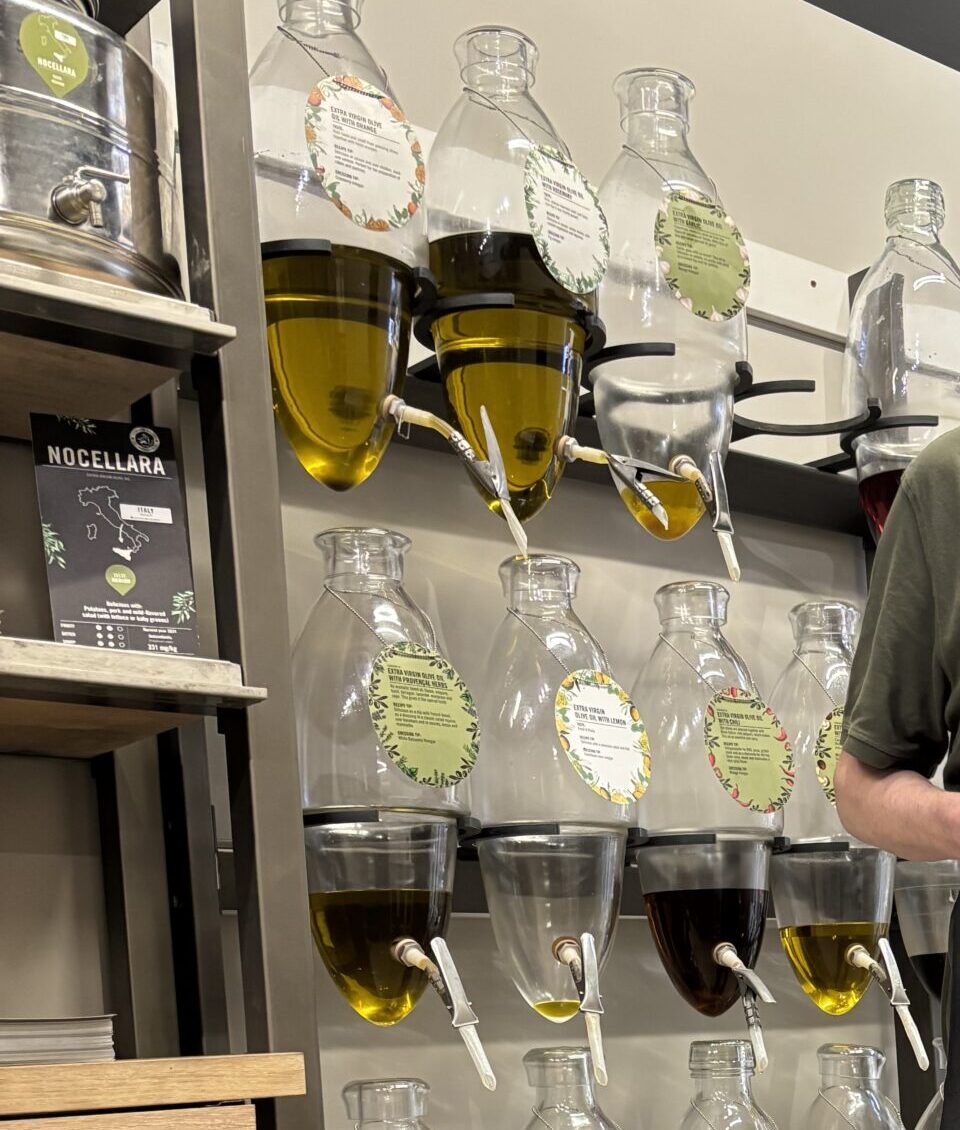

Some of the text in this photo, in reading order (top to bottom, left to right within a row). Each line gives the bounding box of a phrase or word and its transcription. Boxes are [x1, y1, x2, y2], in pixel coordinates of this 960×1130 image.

[38, 57, 76, 77] NOCELLARA
[48, 445, 166, 475] NOCELLARA
[574, 704, 605, 714] EXTRA VIRGIN
[611, 717, 627, 725] LEMON
